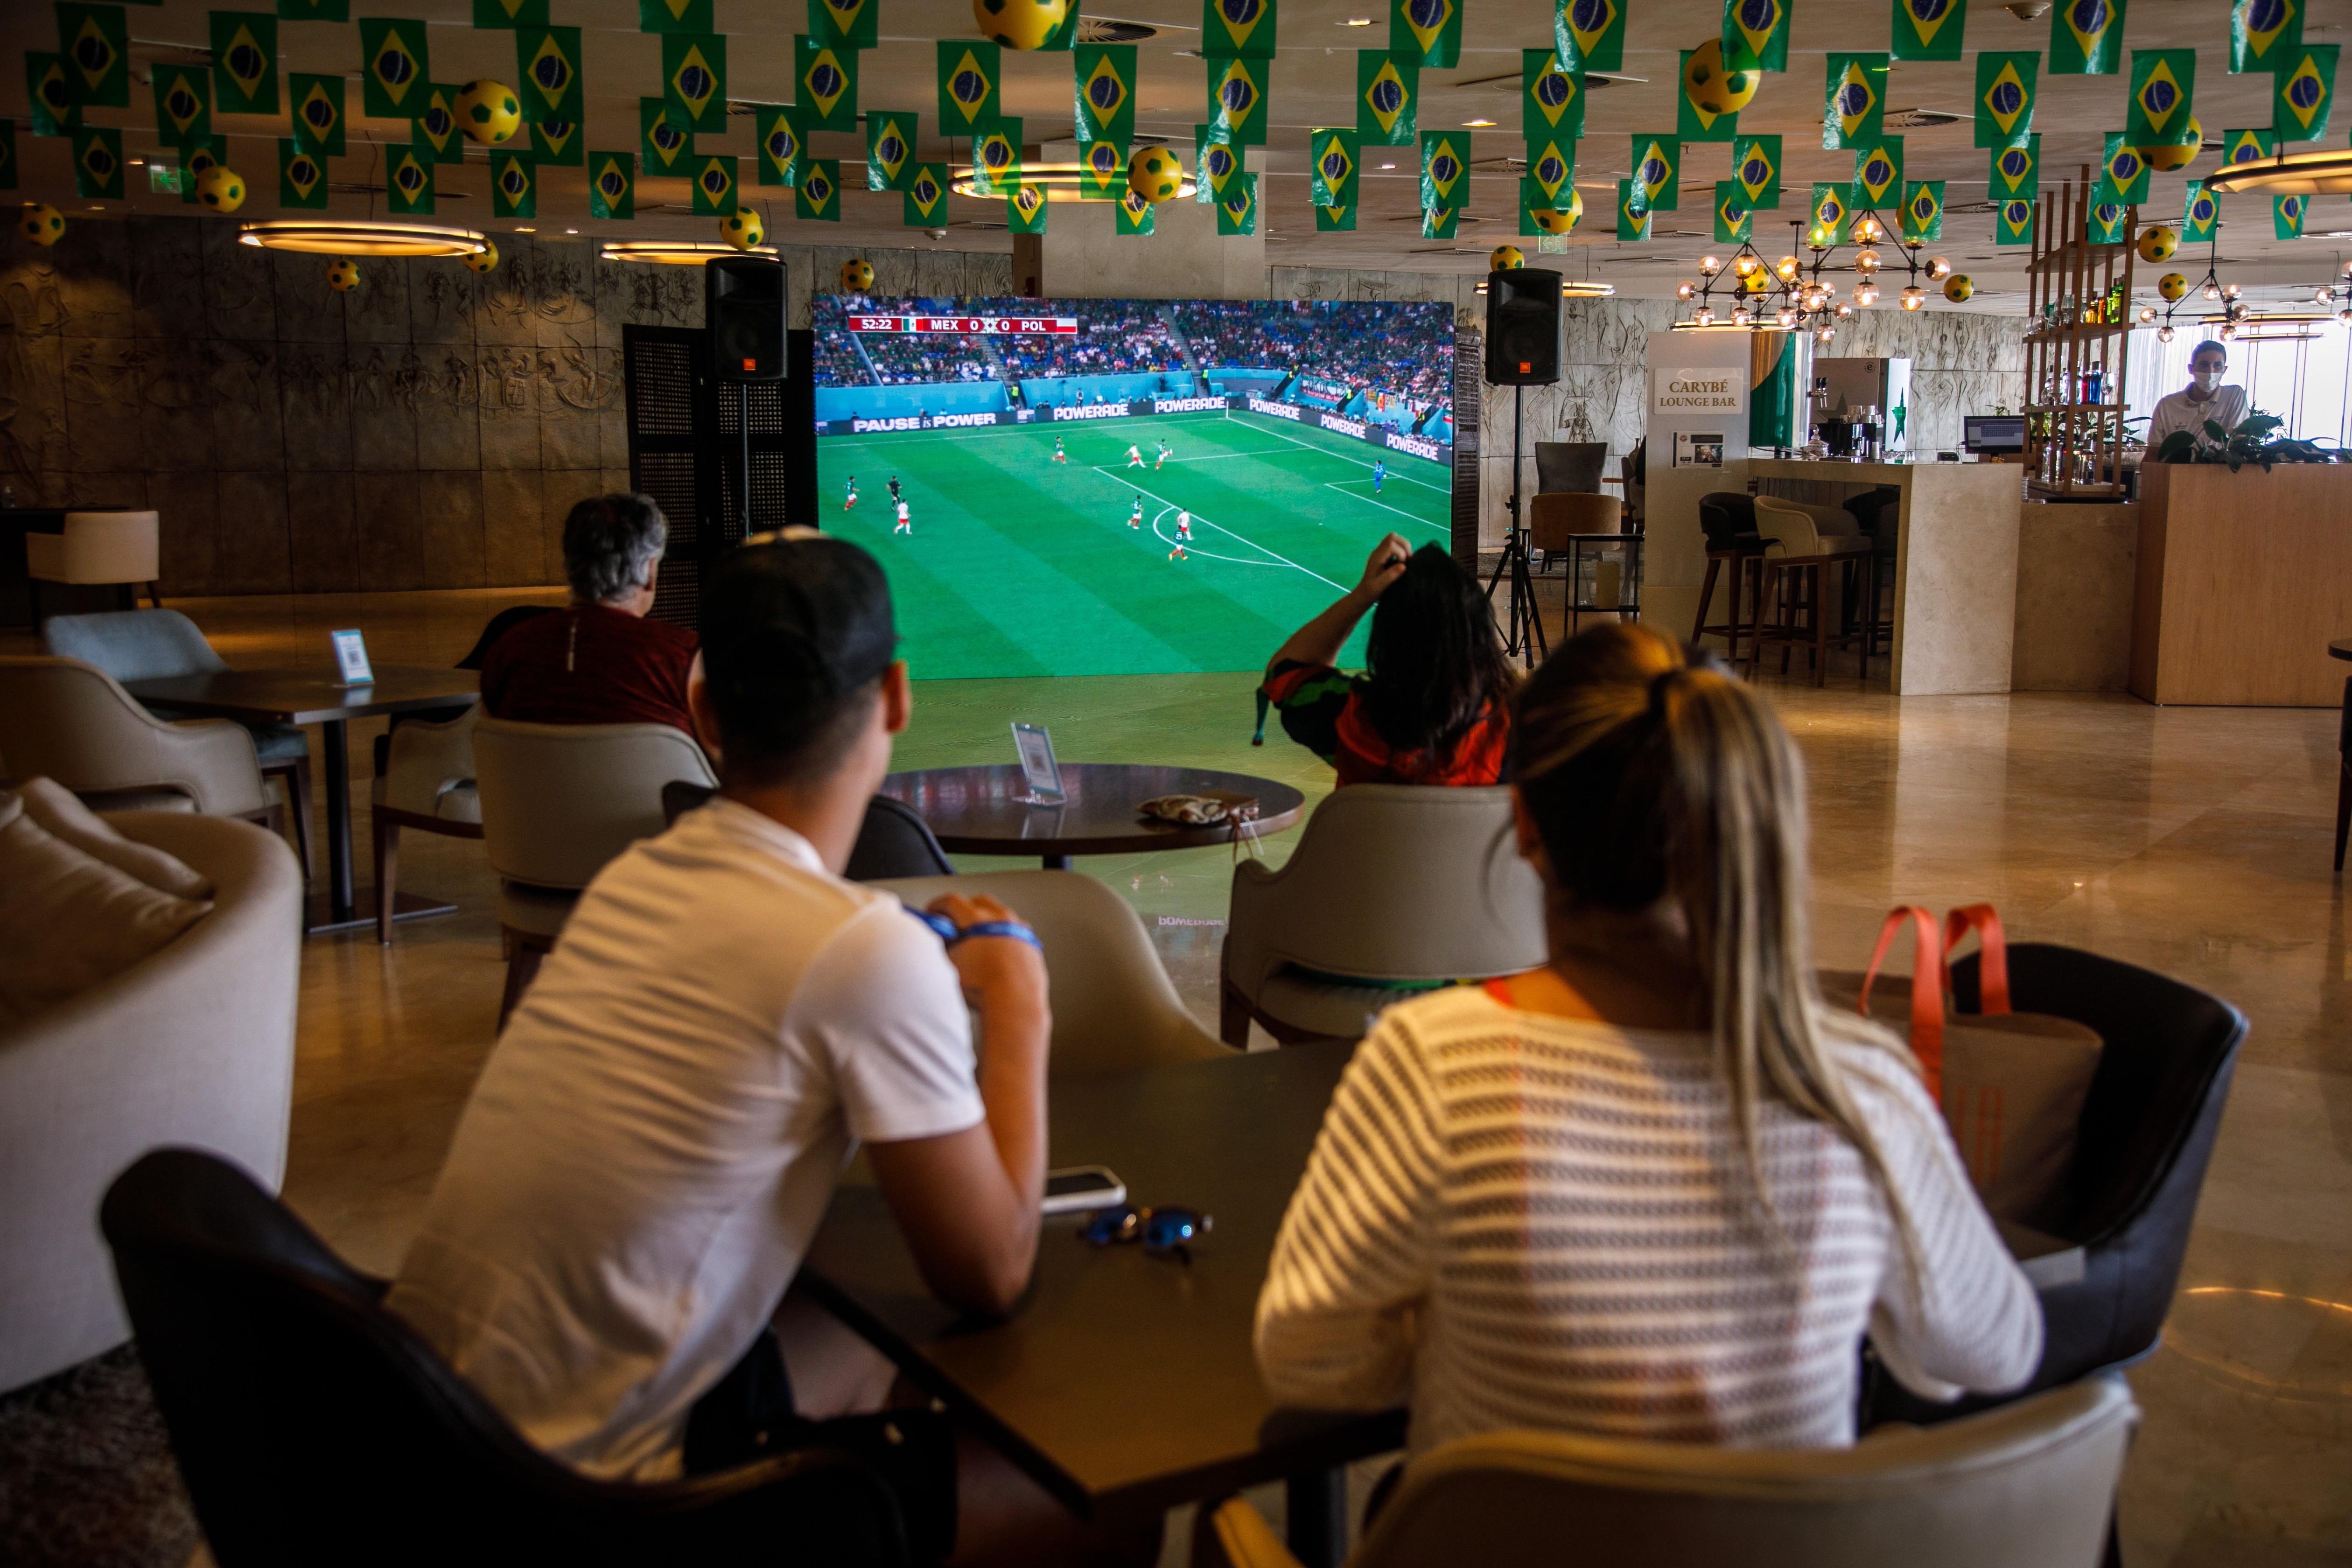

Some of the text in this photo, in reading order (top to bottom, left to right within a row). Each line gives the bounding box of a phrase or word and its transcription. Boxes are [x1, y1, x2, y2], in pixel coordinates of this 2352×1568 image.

[861, 319, 1046, 331] 52:22 MEX 0 0 POL
[1669, 379, 1728, 393] CARYBÉ
[1154, 397, 1226, 413] POWERADE
[1249, 398, 1301, 420] POWERADE
[1659, 397, 1736, 406] LOUNGE BAR
[1054, 403, 1129, 420] POWERADE
[854, 413, 996, 433] PAUSE is POWER
[1321, 413, 1366, 439] POWERADE
[1386, 432, 1438, 461] POWERADE
